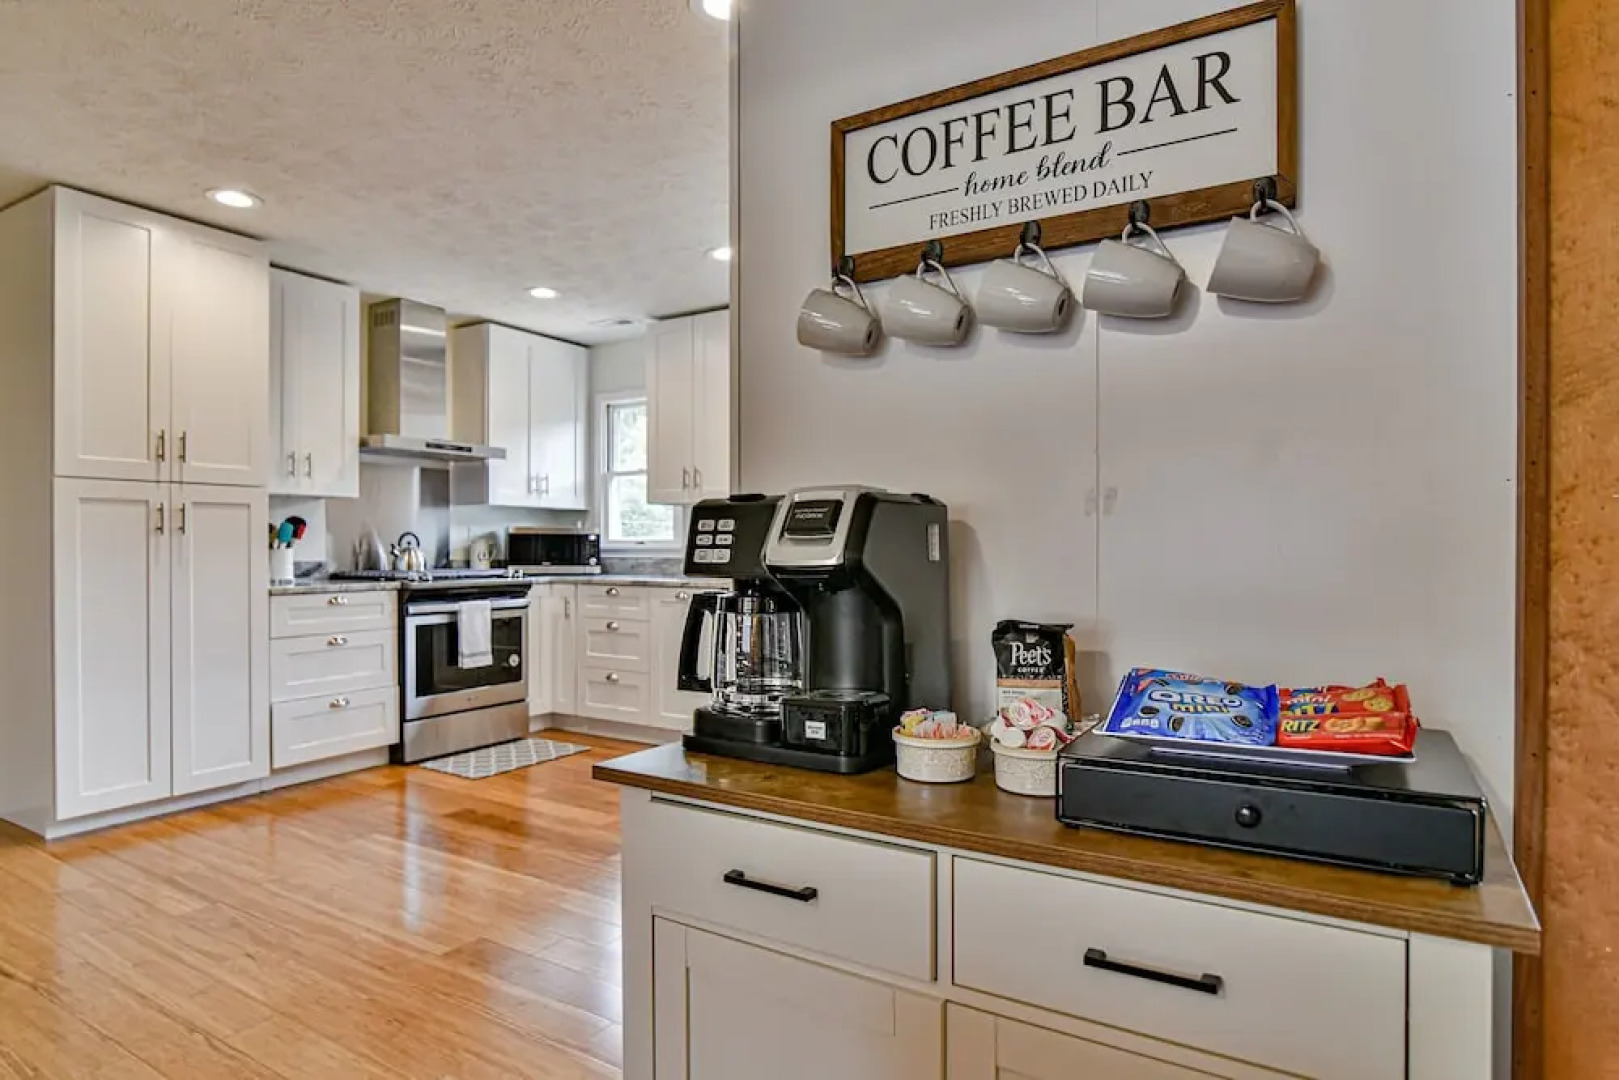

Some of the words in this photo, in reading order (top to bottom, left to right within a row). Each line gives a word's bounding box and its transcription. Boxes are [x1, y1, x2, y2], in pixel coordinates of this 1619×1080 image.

[867, 88, 1077, 184] COFFEE
[1094, 51, 1241, 134] BAR
[964, 171, 1029, 197] home
[1036, 141, 1112, 181] blend
[929, 200, 1003, 230] FRESHLY
[1008, 185, 1087, 215] BREWED
[1093, 171, 1153, 198] DAILY
[1009, 640, 1052, 666] Peet's
[1149, 689, 1244, 709] OREO
[1281, 718, 1321, 733] RITZ
